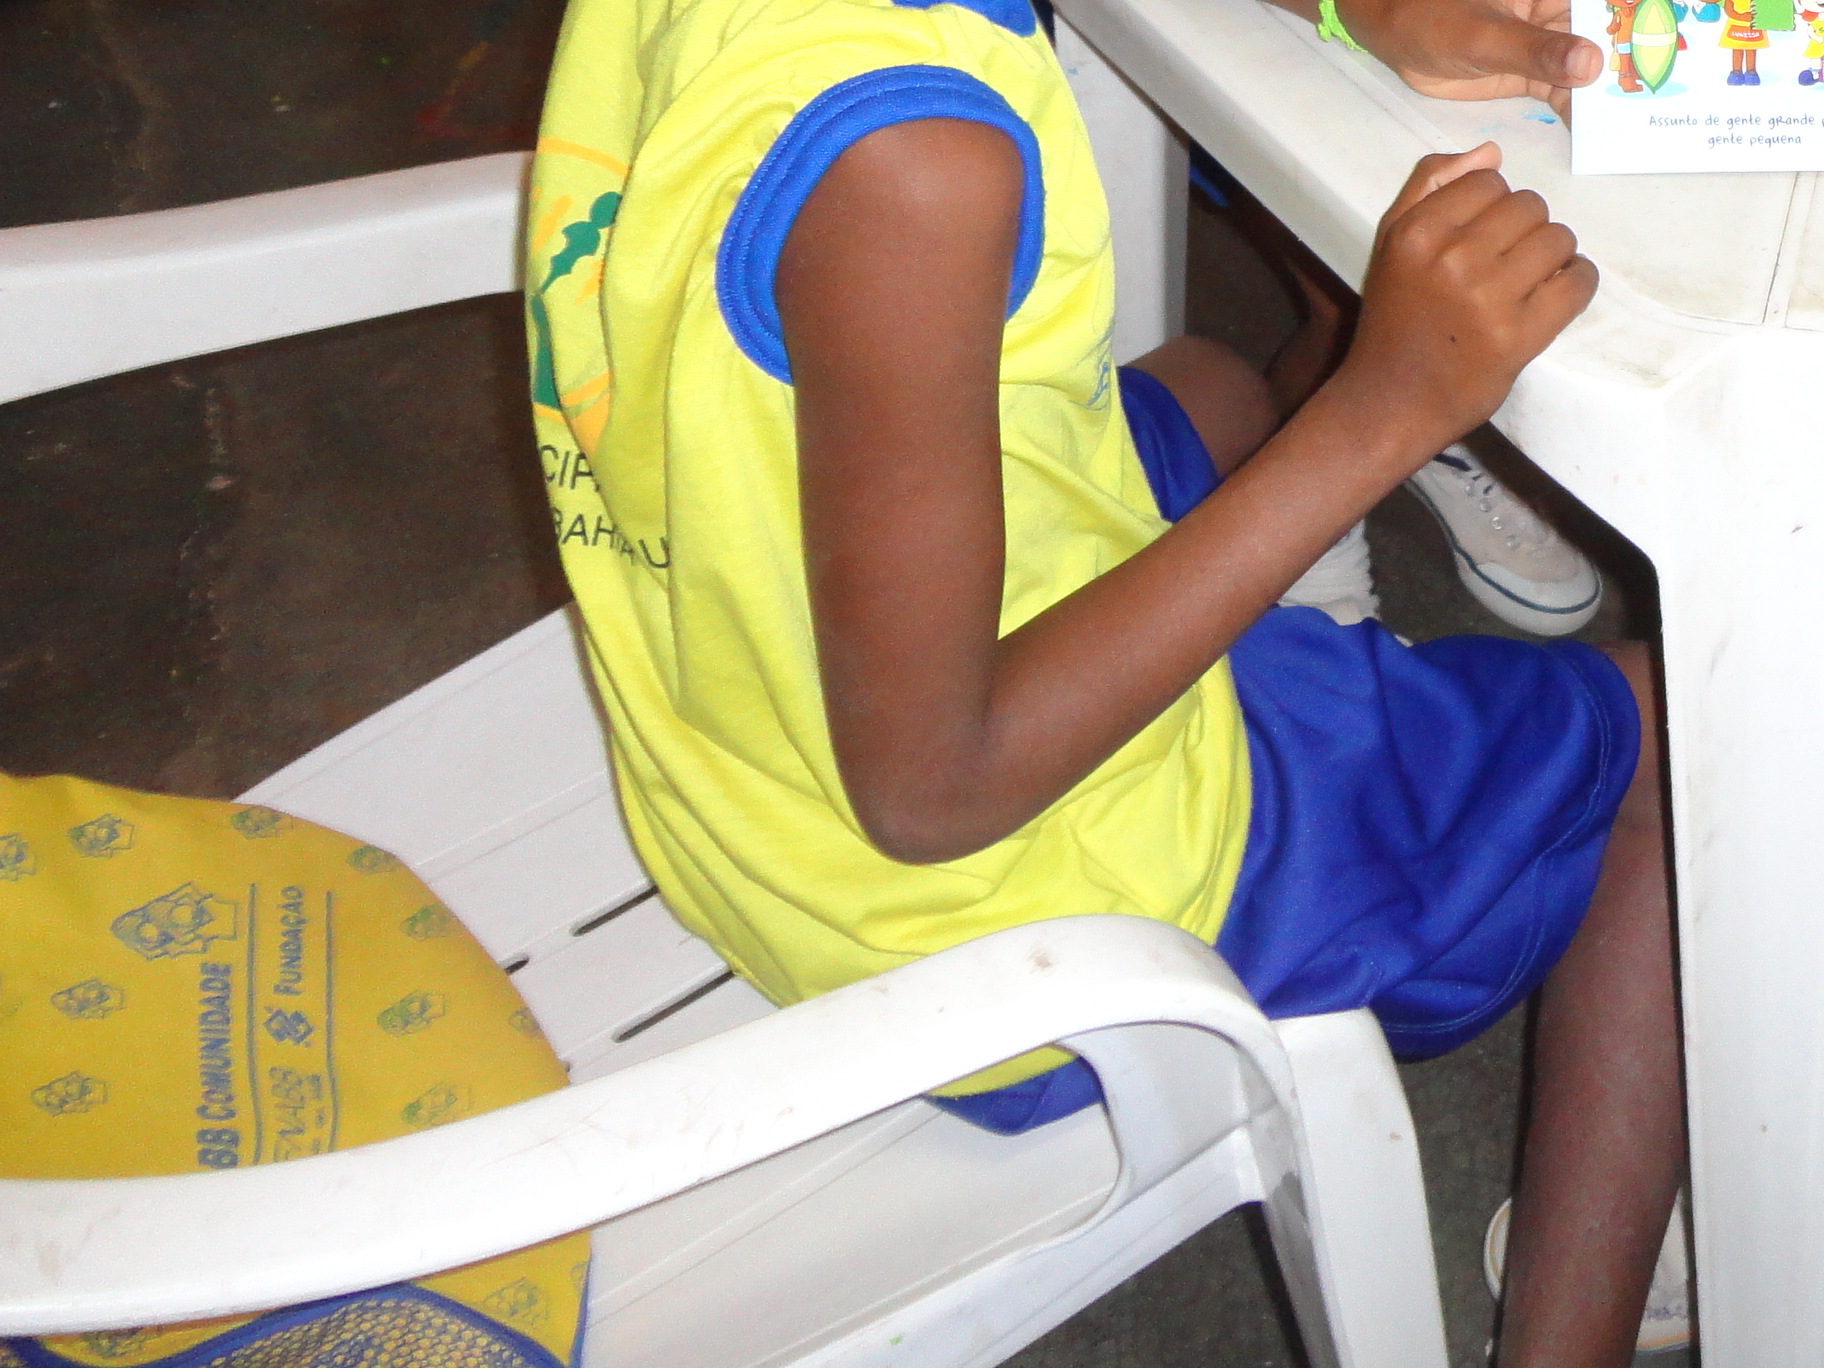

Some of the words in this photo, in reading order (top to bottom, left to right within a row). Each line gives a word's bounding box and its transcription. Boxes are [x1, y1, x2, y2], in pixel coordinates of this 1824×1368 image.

[1649, 115, 1698, 126] Assunto
[1705, 114, 1720, 126] de
[1726, 114, 1761, 130] gente
[1708, 132, 1743, 149] gente
[1750, 135, 1802, 148] pequena
